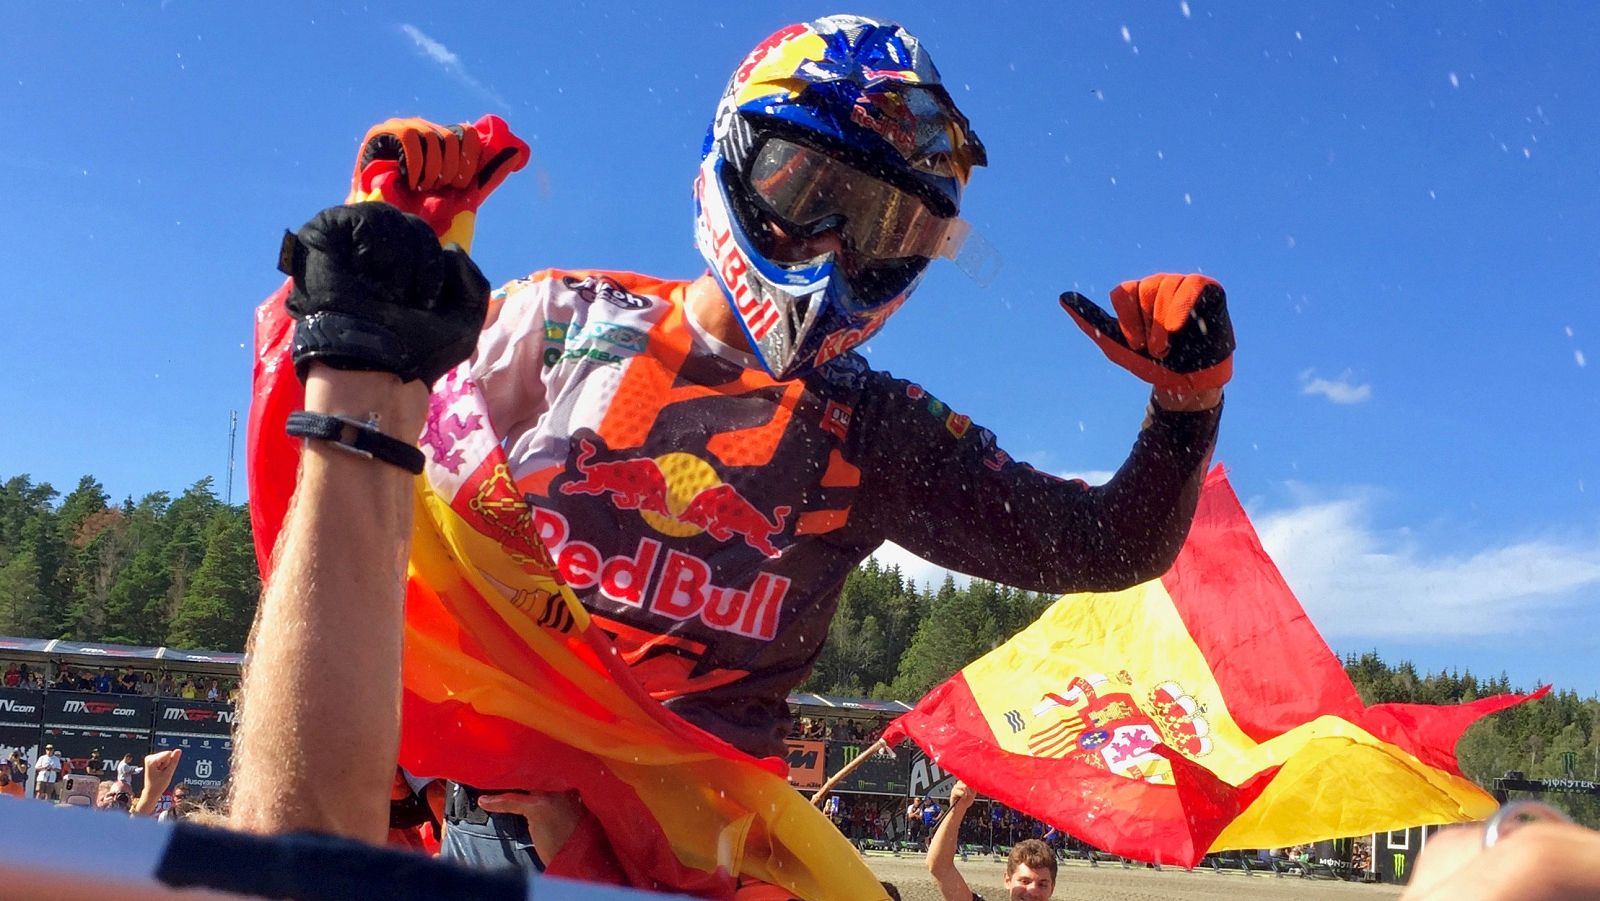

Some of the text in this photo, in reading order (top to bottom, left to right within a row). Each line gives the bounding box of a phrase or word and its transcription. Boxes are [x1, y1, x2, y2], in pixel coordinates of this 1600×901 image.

[531, 505, 792, 641] Red Bull
[1541, 778, 1596, 789] MONSTER
